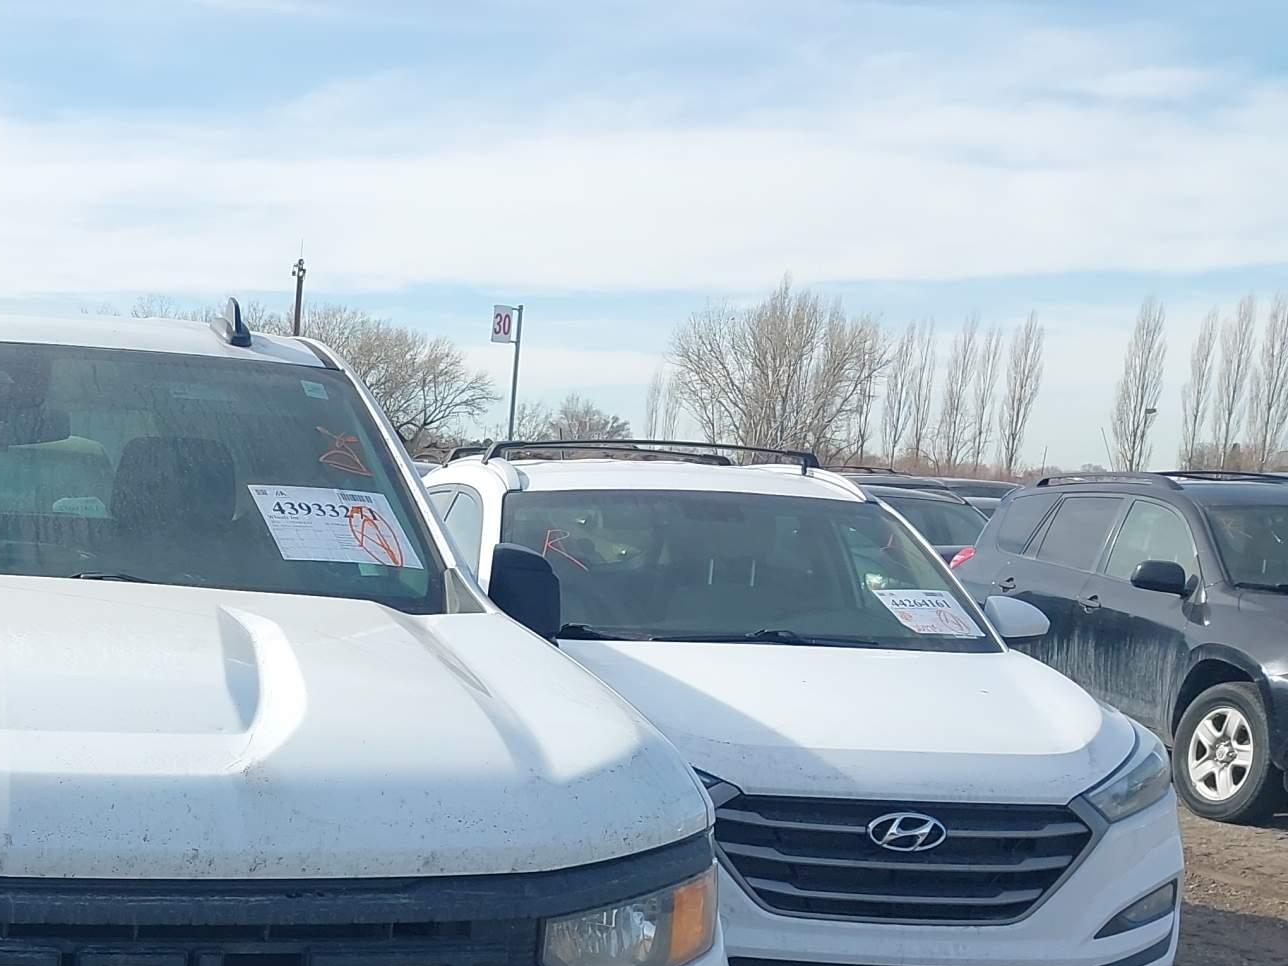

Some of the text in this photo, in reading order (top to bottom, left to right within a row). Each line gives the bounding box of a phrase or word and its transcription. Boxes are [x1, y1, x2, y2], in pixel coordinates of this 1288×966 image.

[494, 312, 511, 336] 30
[272, 501, 380, 521] 43933271
[542, 529, 589, 571] R
[891, 599, 952, 609] 44264161
